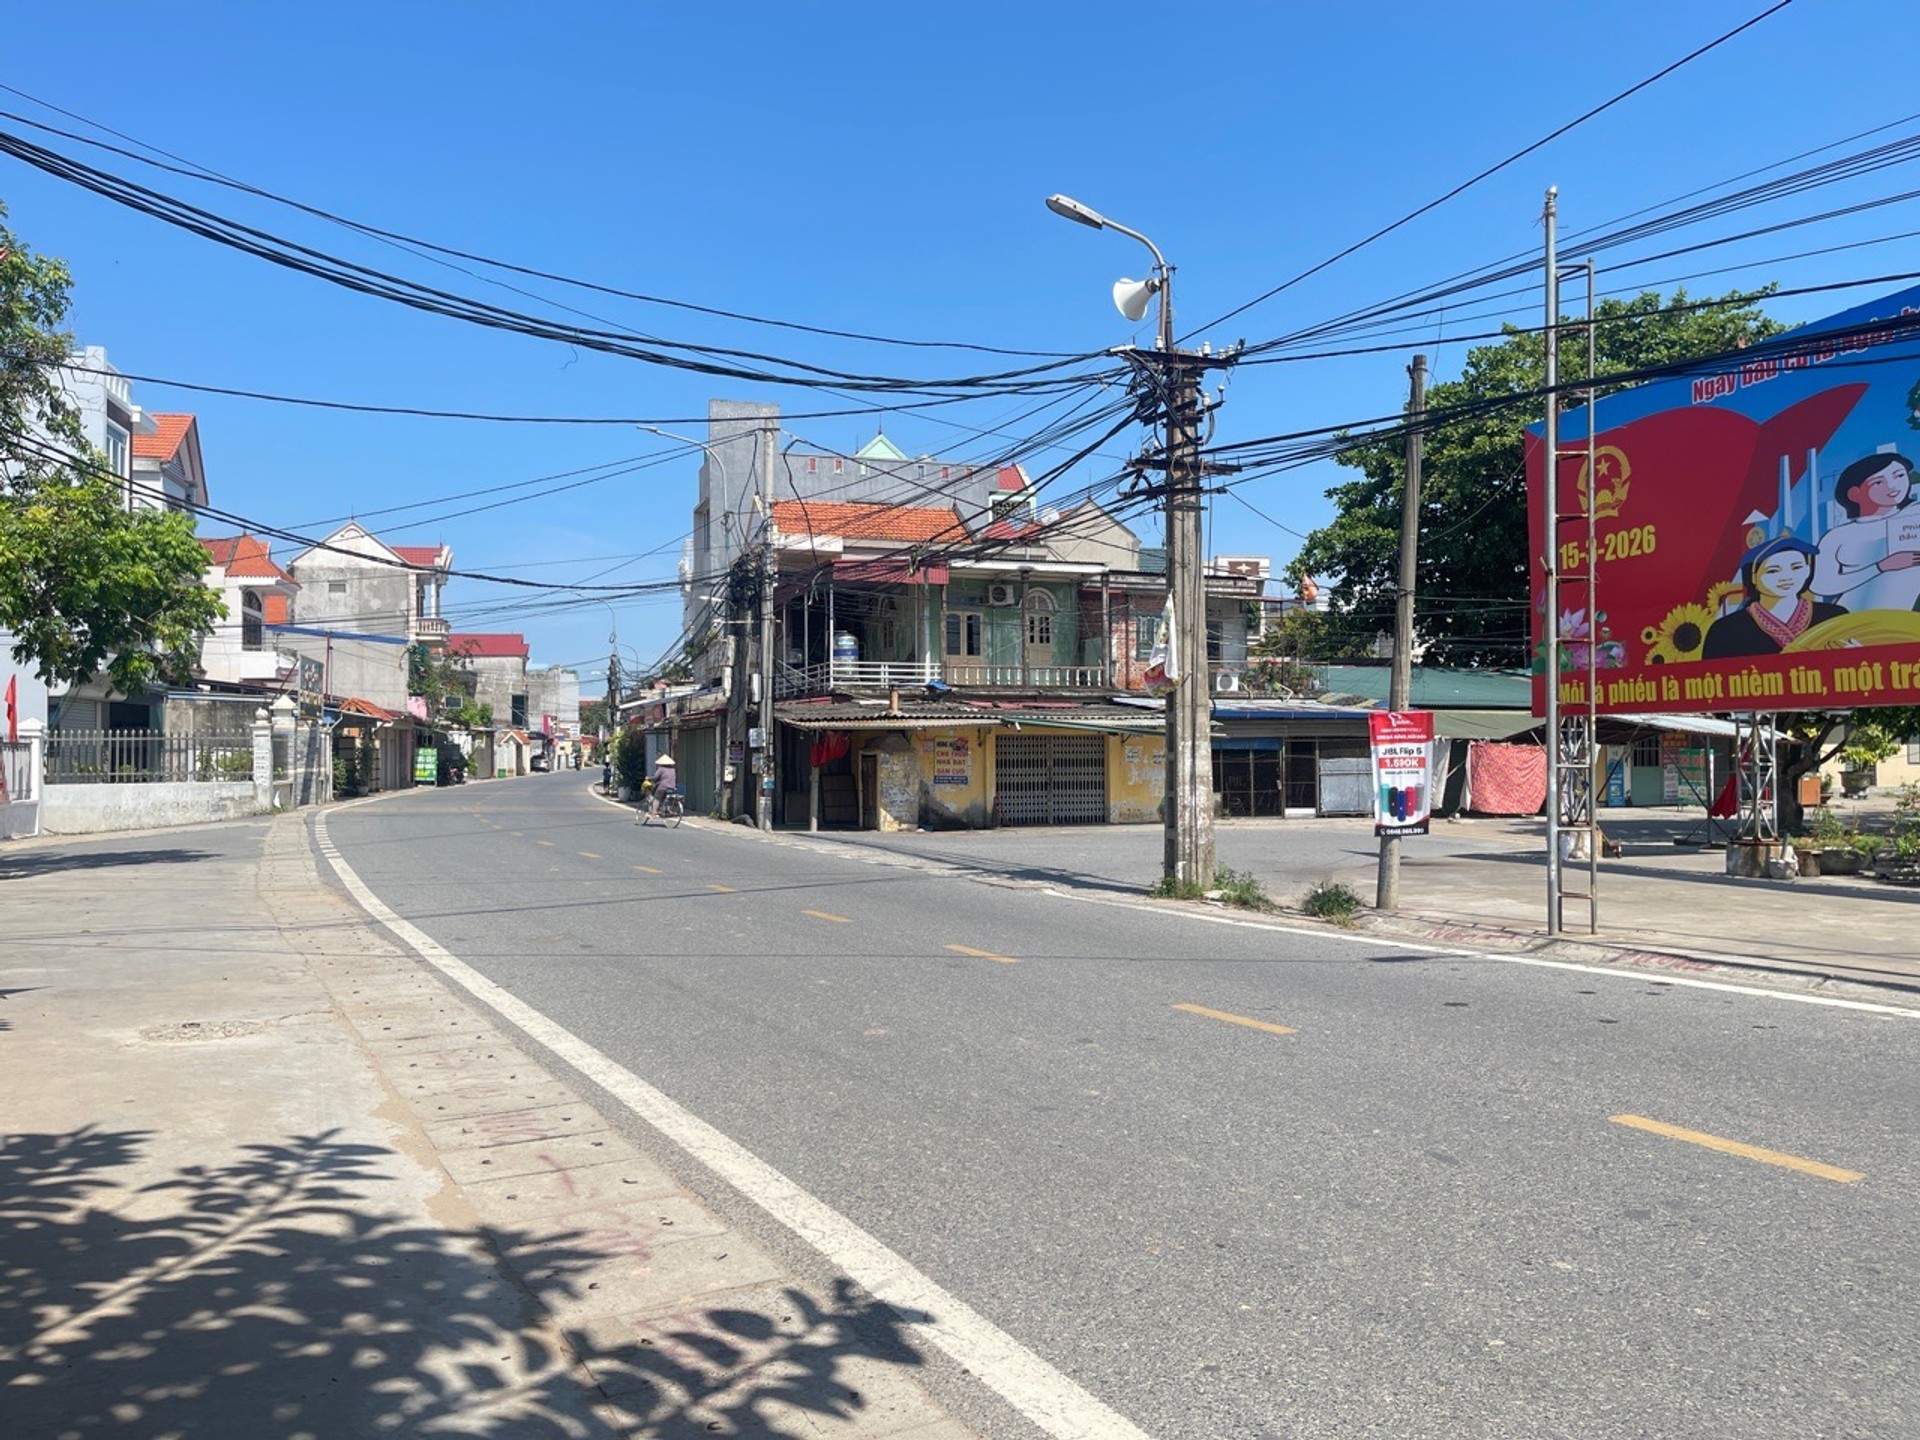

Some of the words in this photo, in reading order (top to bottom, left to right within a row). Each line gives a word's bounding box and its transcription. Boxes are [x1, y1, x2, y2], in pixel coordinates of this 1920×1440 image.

[1608, 674, 1657, 706] phiếu
[1661, 675, 1680, 701] là
[1685, 673, 1724, 704] một
[1728, 664, 1785, 698] niềm
[1789, 665, 1828, 697] tin,
[1833, 660, 1884, 697] một
